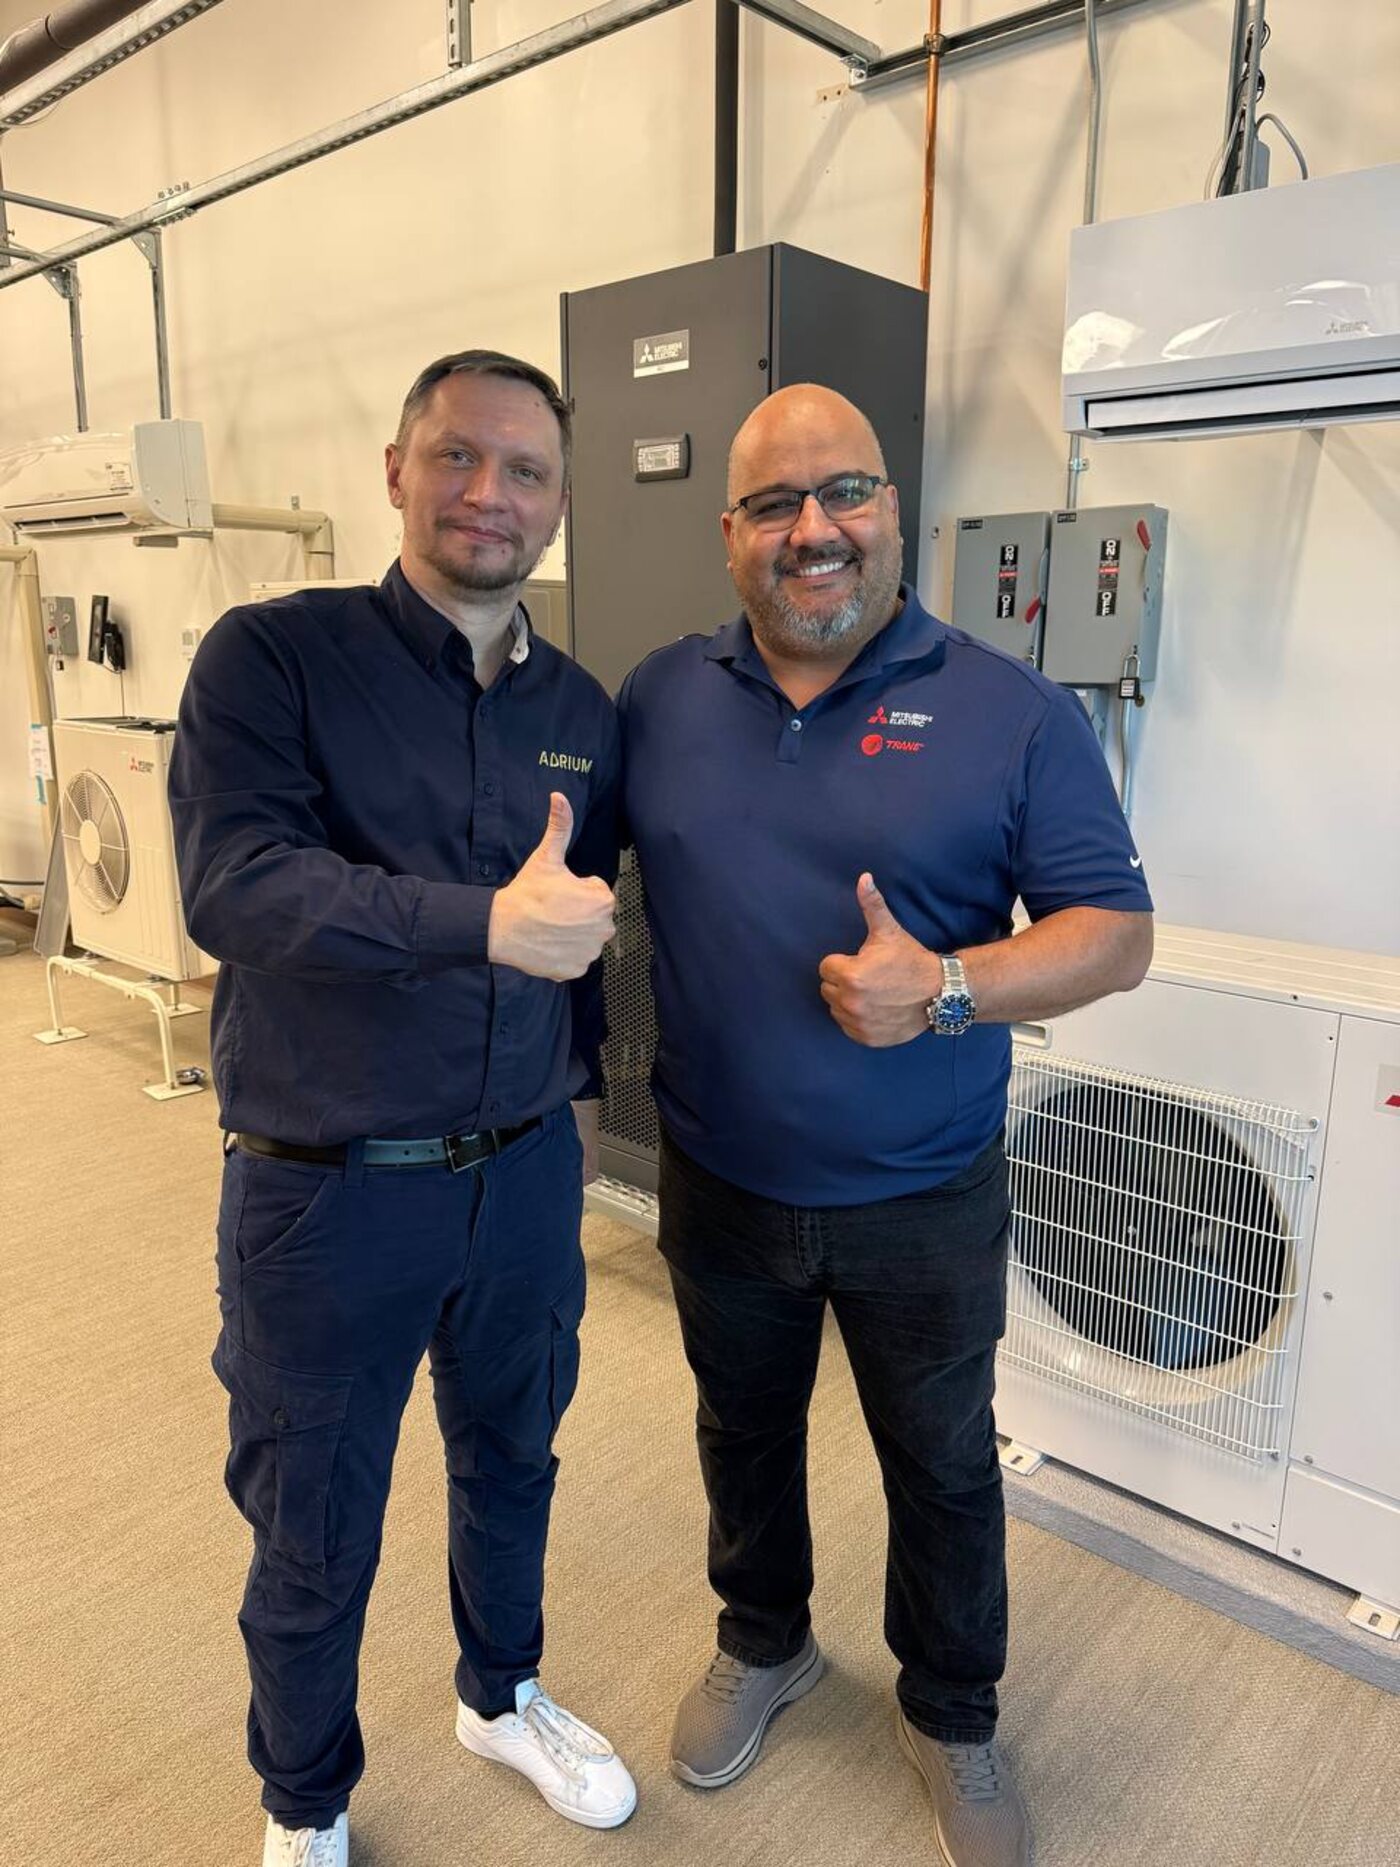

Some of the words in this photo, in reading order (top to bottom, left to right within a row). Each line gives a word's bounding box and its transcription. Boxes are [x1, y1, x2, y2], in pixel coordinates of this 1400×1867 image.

[1005, 545, 1014, 560] ON
[1106, 539, 1116, 555] ON
[1002, 594, 1012, 618] OFF
[1101, 591, 1112, 615] OFF
[889, 718, 925, 727] ELECTRIC
[886, 739, 921, 751] TRANE
[538, 750, 593, 774] ADRIUM
